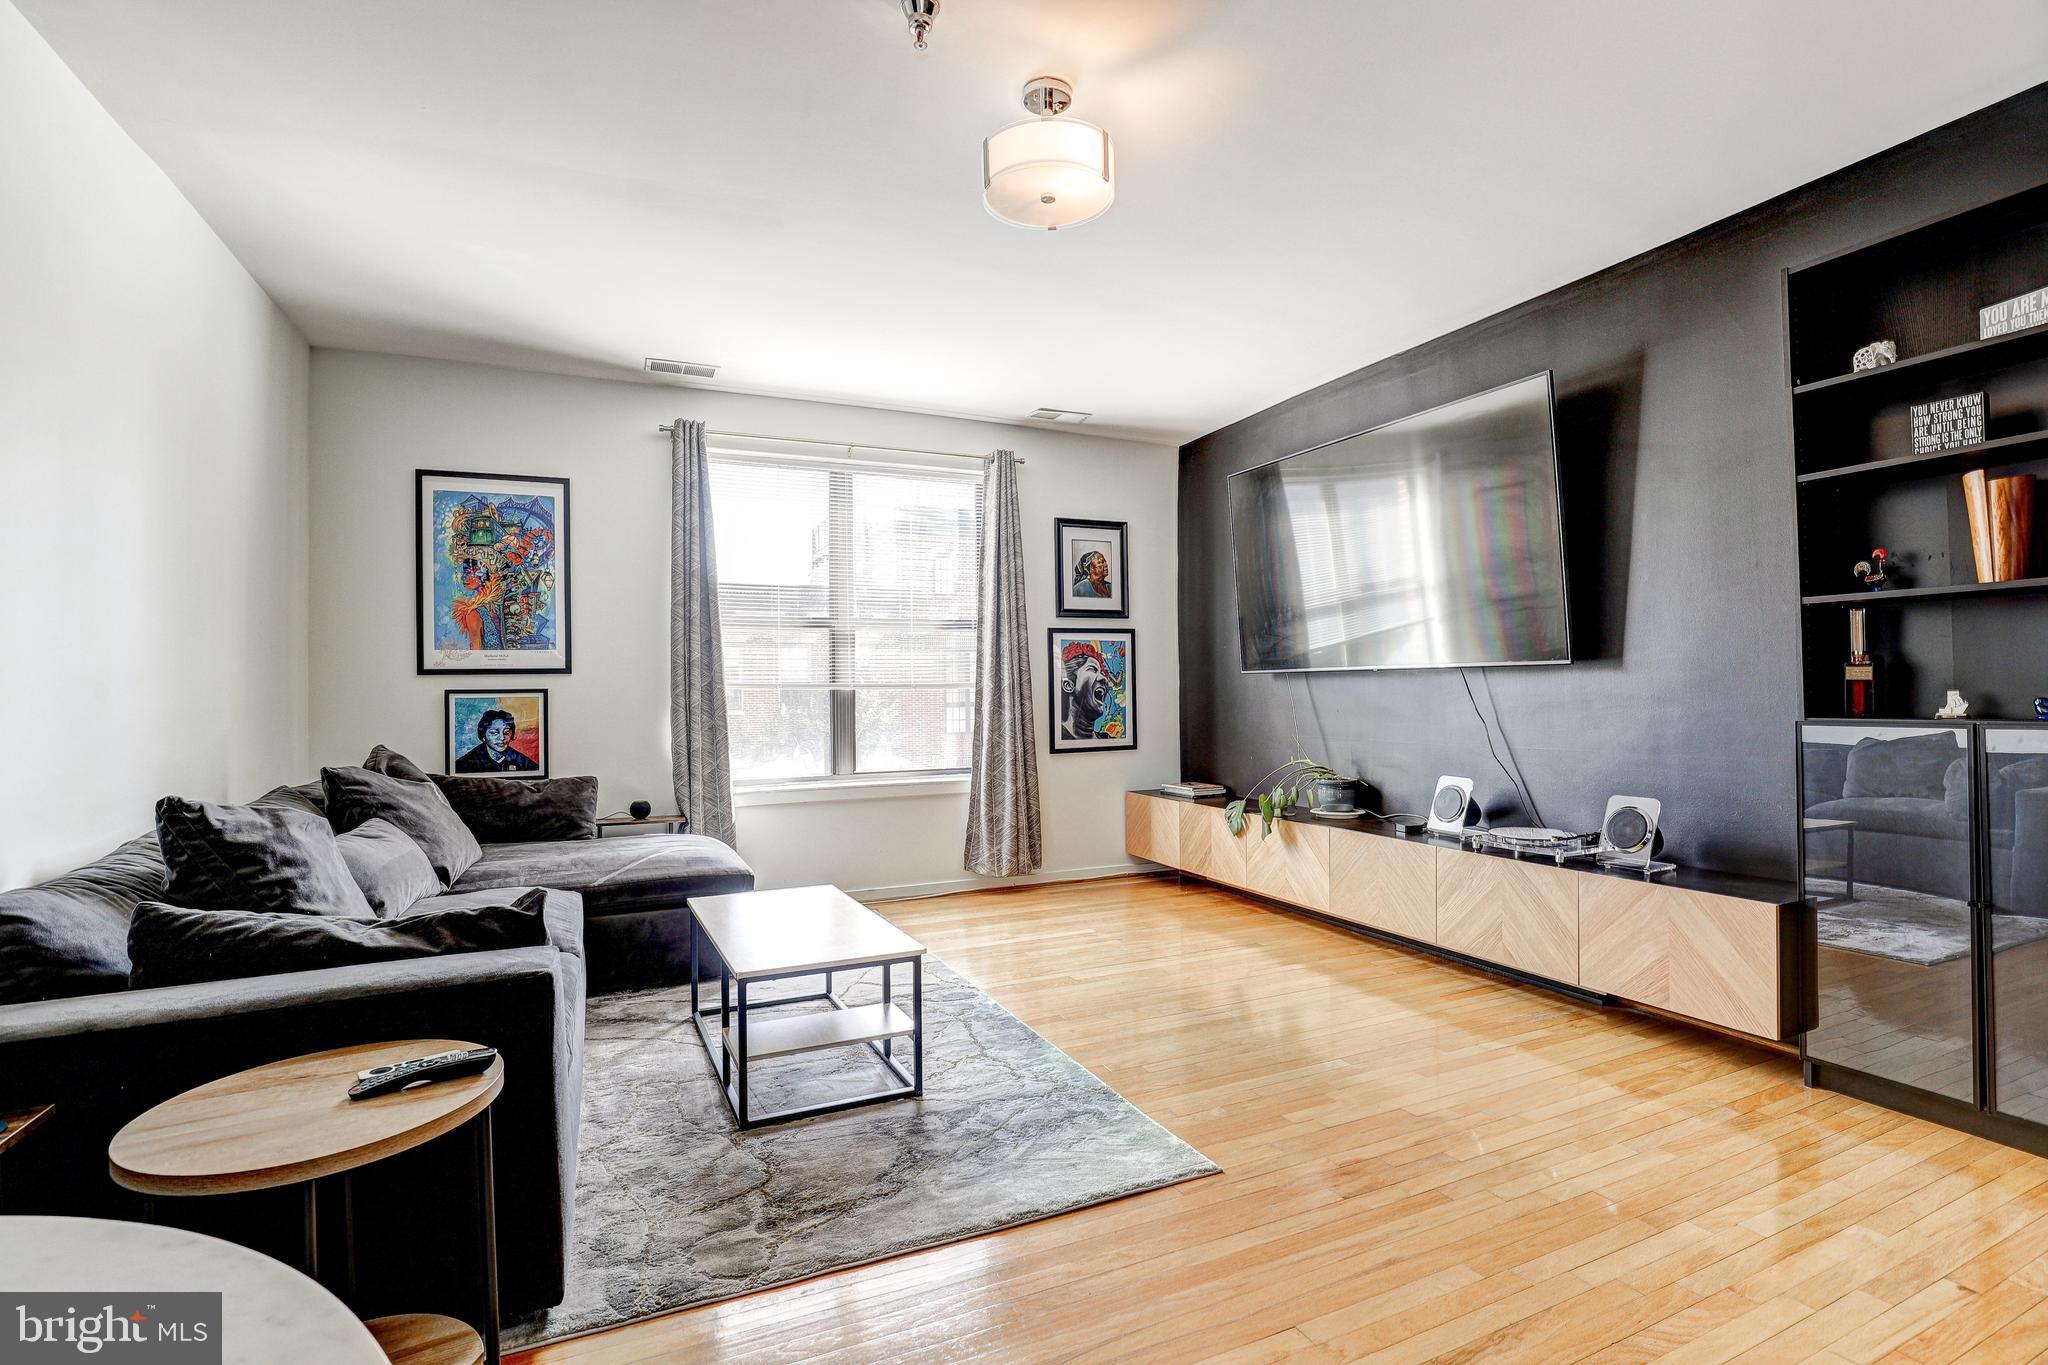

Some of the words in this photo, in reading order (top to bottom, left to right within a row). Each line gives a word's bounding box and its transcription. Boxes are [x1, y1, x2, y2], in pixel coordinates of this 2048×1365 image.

[1984, 304, 2007, 326] YOU
[2012, 295, 2037, 318] ARE
[1984, 322, 2007, 338] LOVED
[2010, 316, 2026, 329] YOU
[1913, 405, 1927, 417] YOU
[1930, 400, 1954, 414] NEVER
[1957, 394, 1981, 409] KNOW
[1914, 415, 1931, 427] HOW
[1934, 409, 1963, 423] STRONG
[1966, 405, 1981, 417] YOU
[1914, 426, 1928, 437] ARE
[1932, 421, 1954, 434] UNTIL
[1958, 416, 1981, 429] BEING
[1915, 434, 1940, 447] STRONG
[1942, 433, 1948, 443] IS
[1951, 430, 1963, 441] THE
[1965, 426, 1982, 438] ONLY
